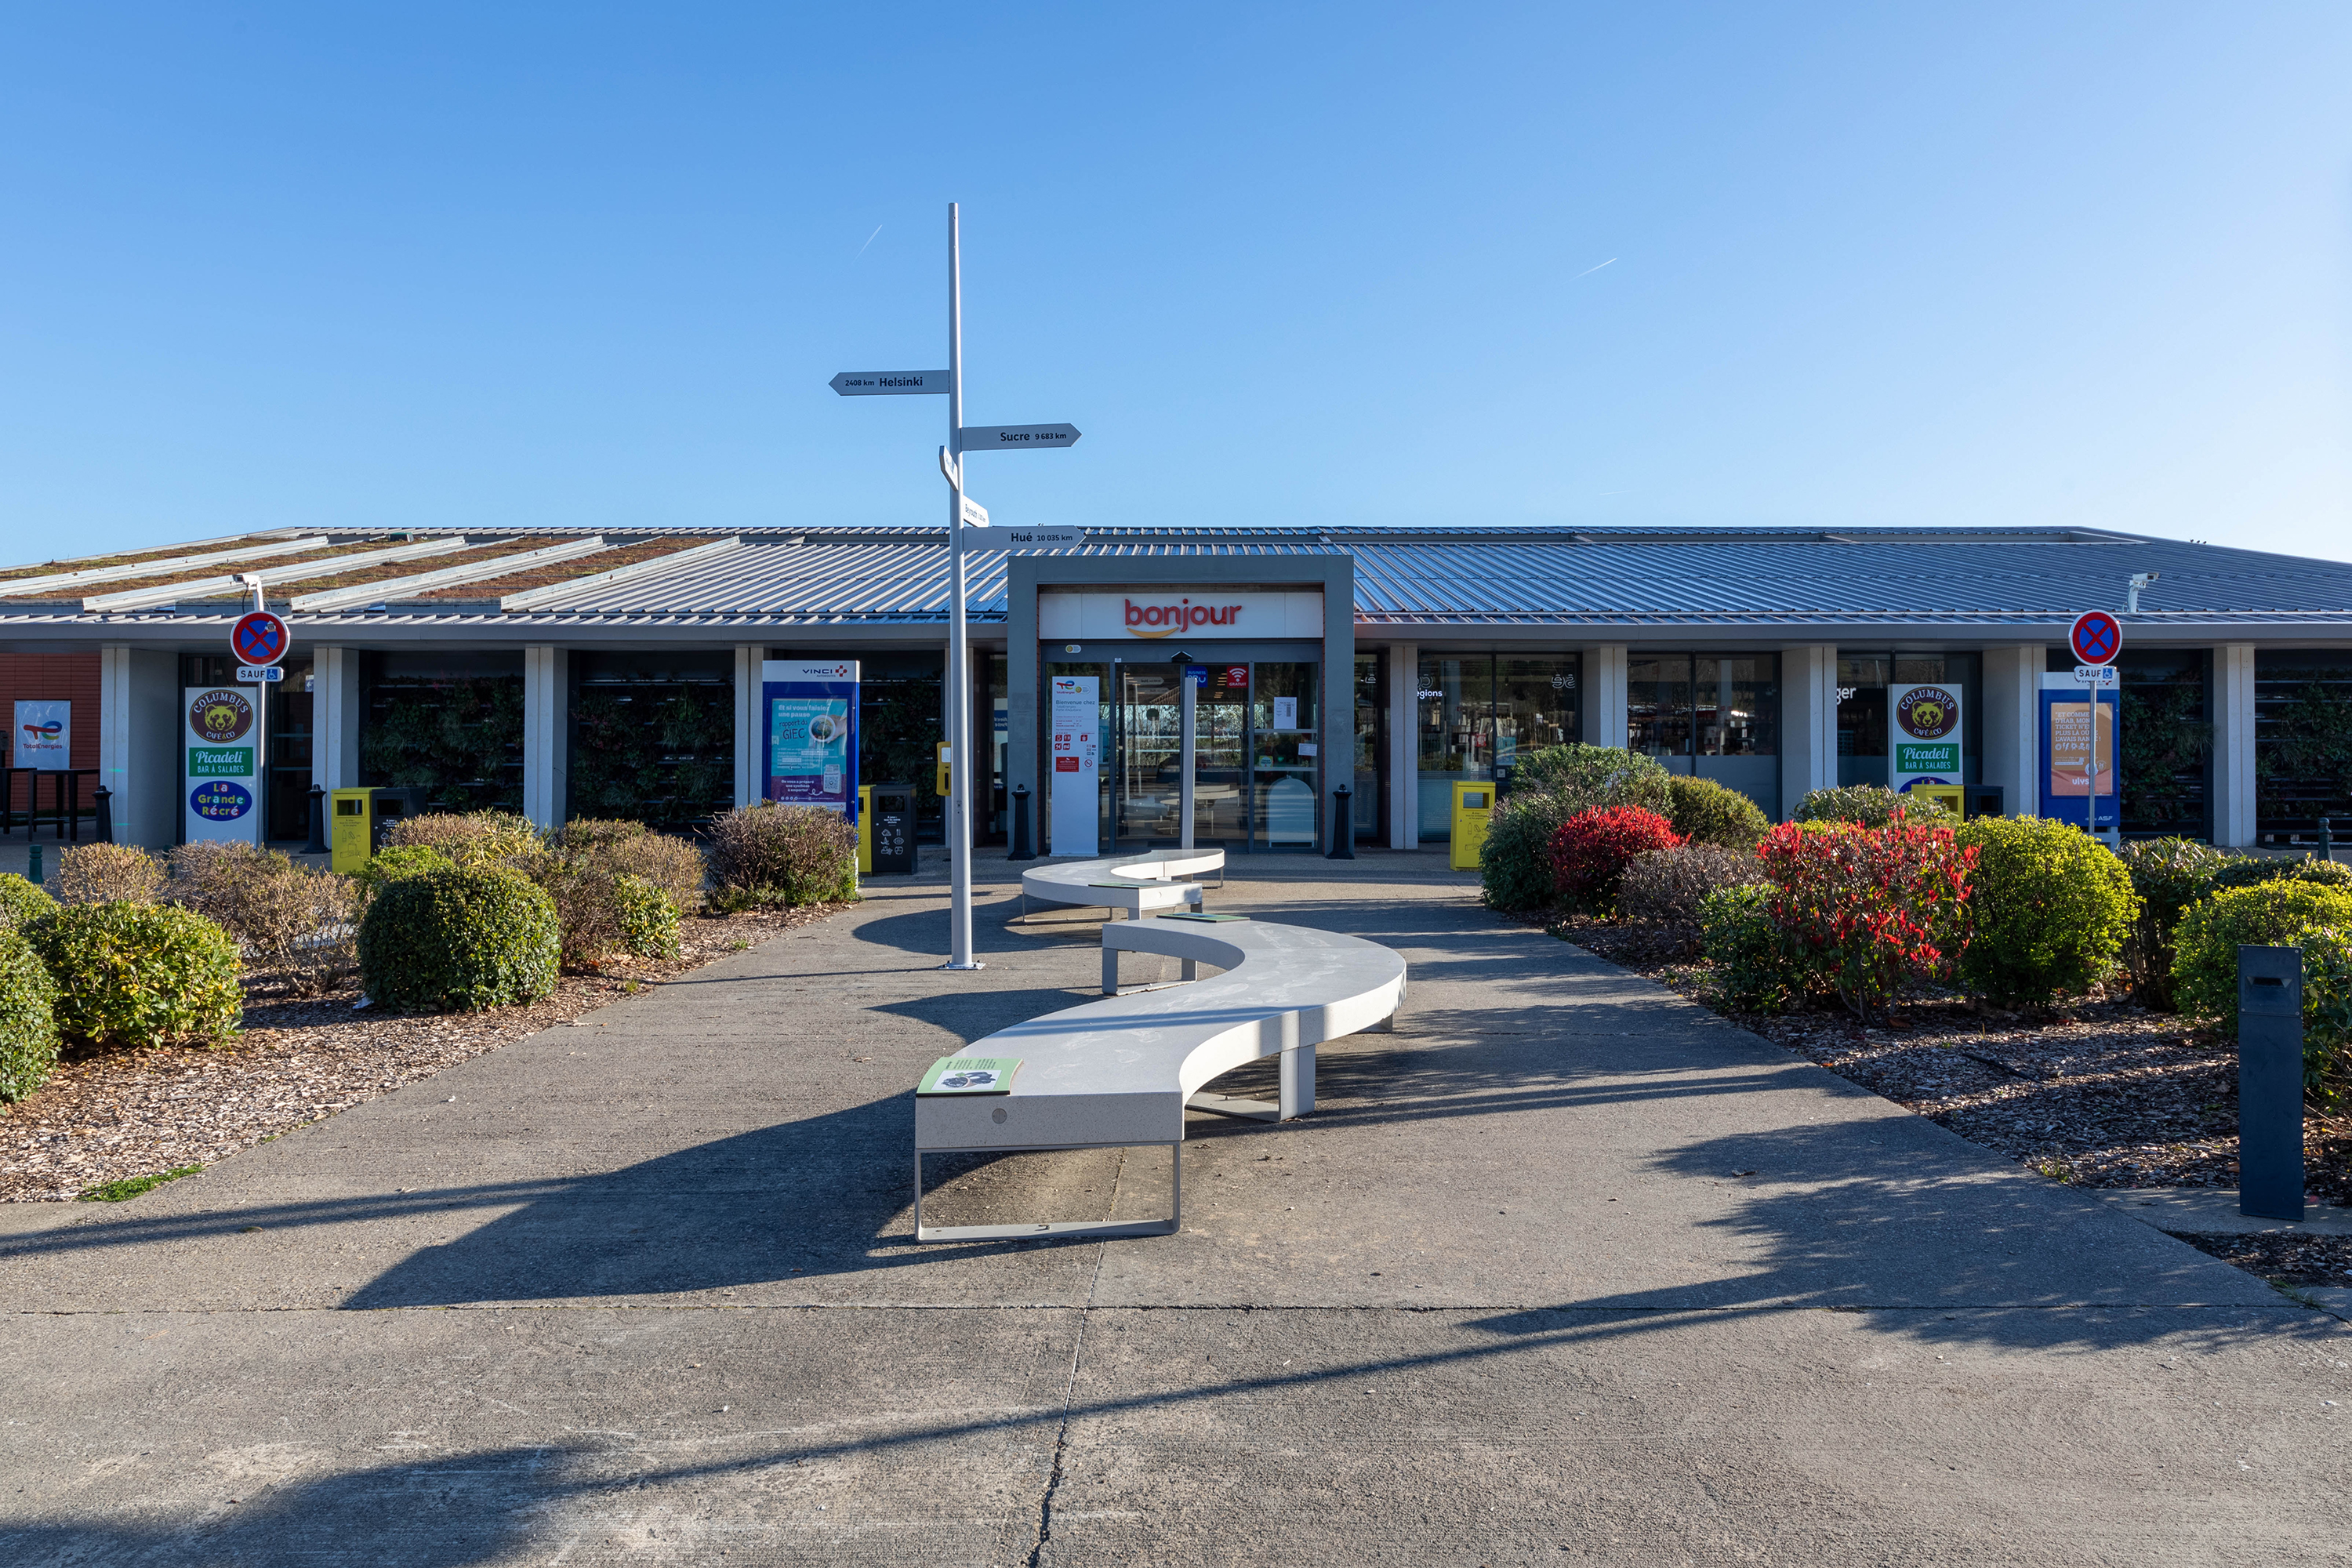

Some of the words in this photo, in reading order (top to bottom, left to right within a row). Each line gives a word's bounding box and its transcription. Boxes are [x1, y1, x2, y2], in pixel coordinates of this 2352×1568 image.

[879, 376, 923, 387] Helsinki
[1000, 432, 1030, 441] Sucre
[1011, 532, 1033, 542] Hué
[1125, 598, 1242, 633] bonjour
[193, 692, 249, 713] COLUMBUS
[1900, 689, 1955, 710] COLUMBUS
[779, 719, 800, 728] rapport
[782, 728, 805, 740] GIEC
[195, 750, 243, 764] Picadeli
[1903, 746, 1950, 760] Picadeli
[197, 765, 209, 774] BAR
[211, 764, 216, 773] À
[1918, 760, 1923, 769] À
[2072, 777, 2090, 786] ulys
[213, 783, 228, 793] La
[198, 794, 244, 804] Grande
[202, 805, 239, 816] Récré
